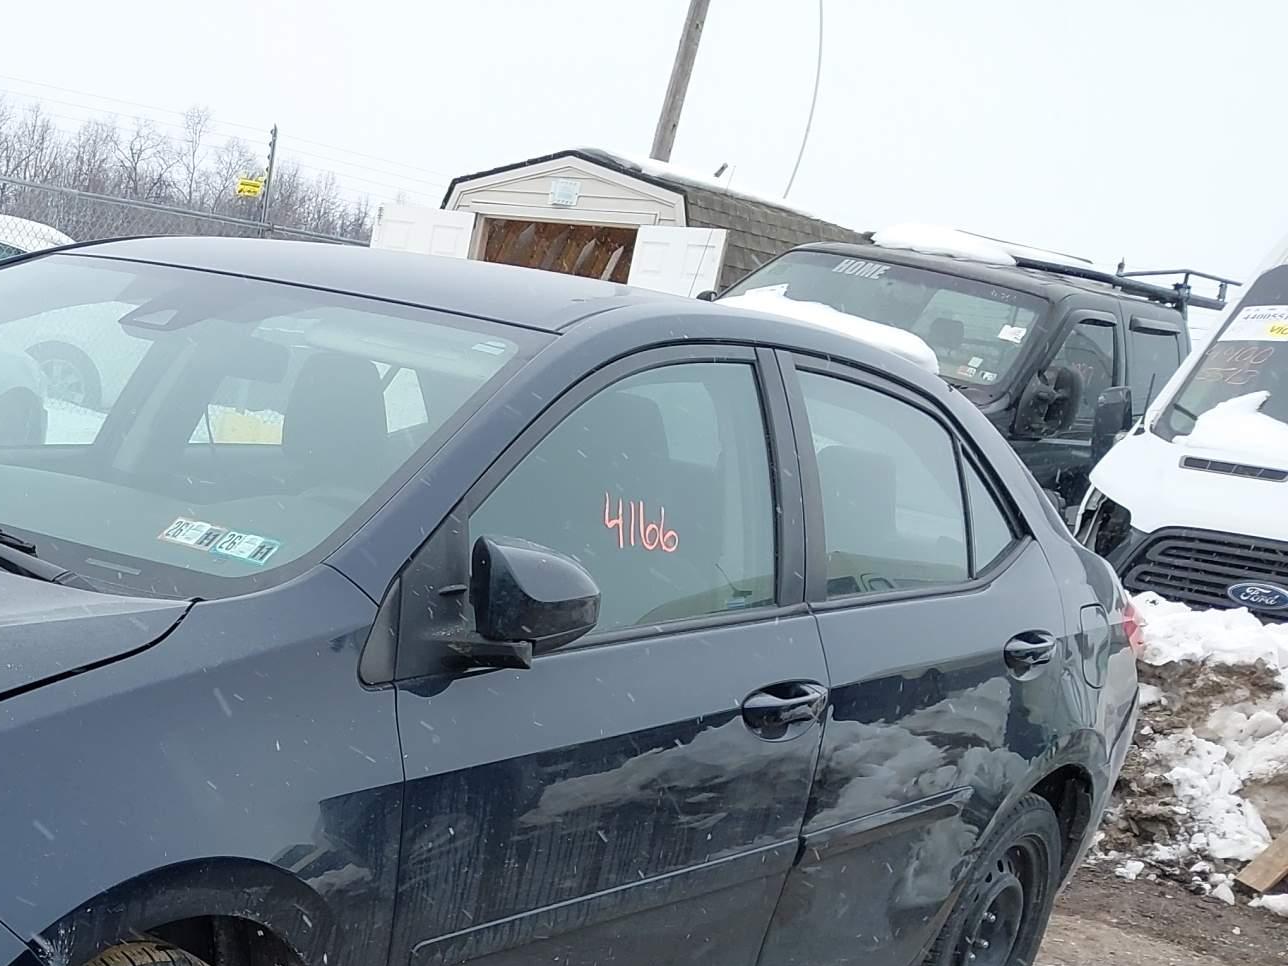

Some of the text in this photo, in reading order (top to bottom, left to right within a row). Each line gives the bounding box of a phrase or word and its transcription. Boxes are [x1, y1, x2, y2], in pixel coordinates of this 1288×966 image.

[832, 259, 891, 279] HOME
[166, 521, 189, 538] 26
[604, 491, 679, 552] 4166
[220, 533, 243, 551] 26
[1240, 586, 1280, 605] Ford
